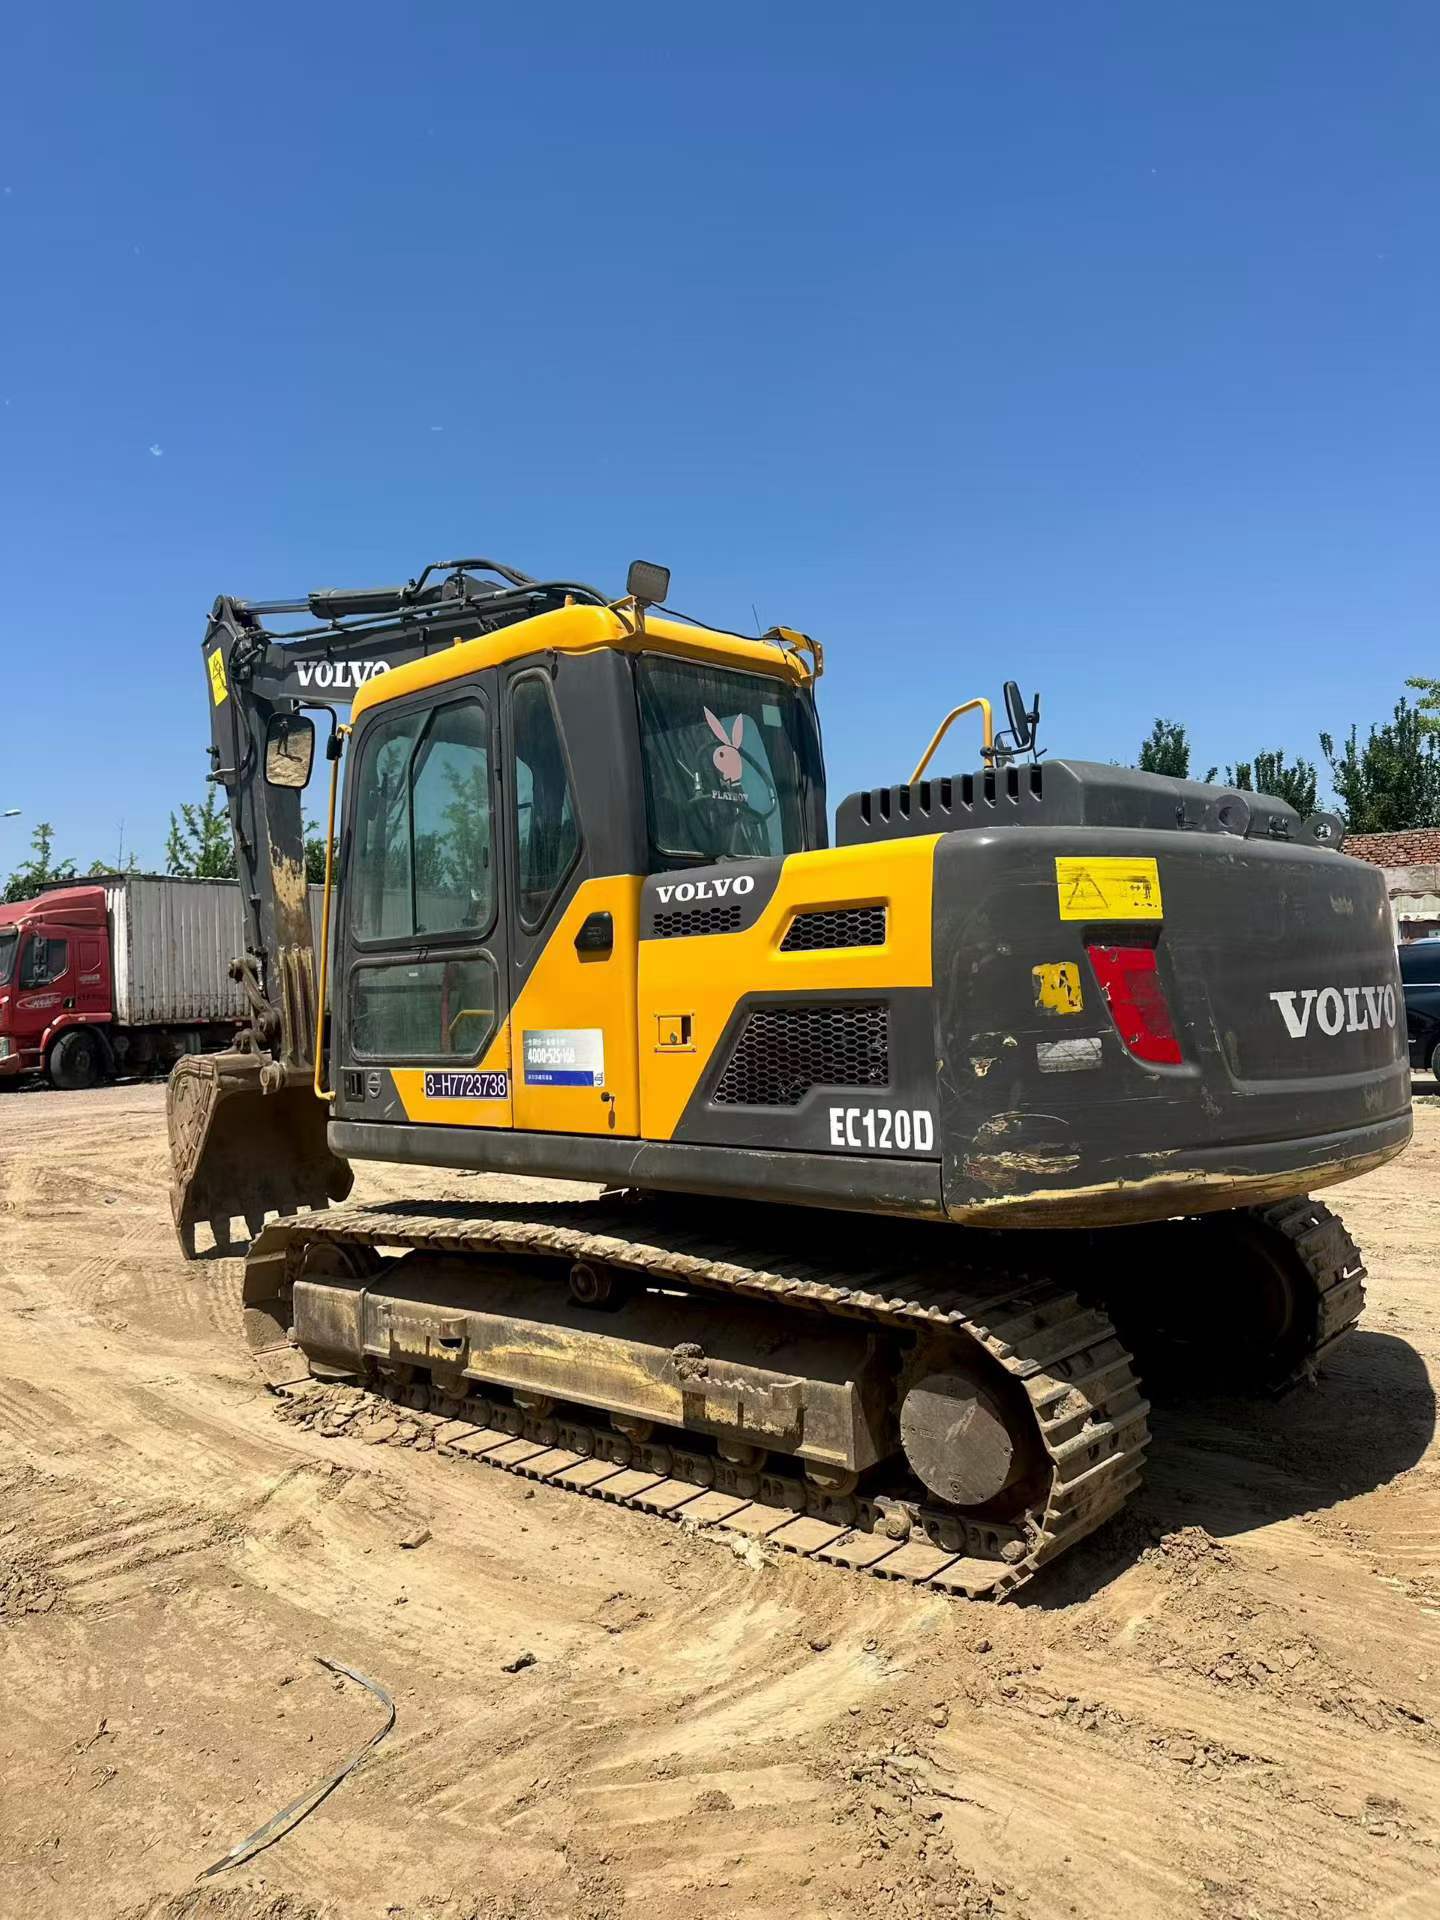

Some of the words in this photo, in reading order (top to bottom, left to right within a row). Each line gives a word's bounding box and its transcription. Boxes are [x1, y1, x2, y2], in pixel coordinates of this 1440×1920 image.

[293, 660, 391, 687] VOLVO
[656, 875, 755, 904] VOLVO
[1269, 983, 1397, 1039] VOLVO
[426, 1074, 506, 1096] 3-H7723738
[829, 1107, 934, 1151] EC120D
